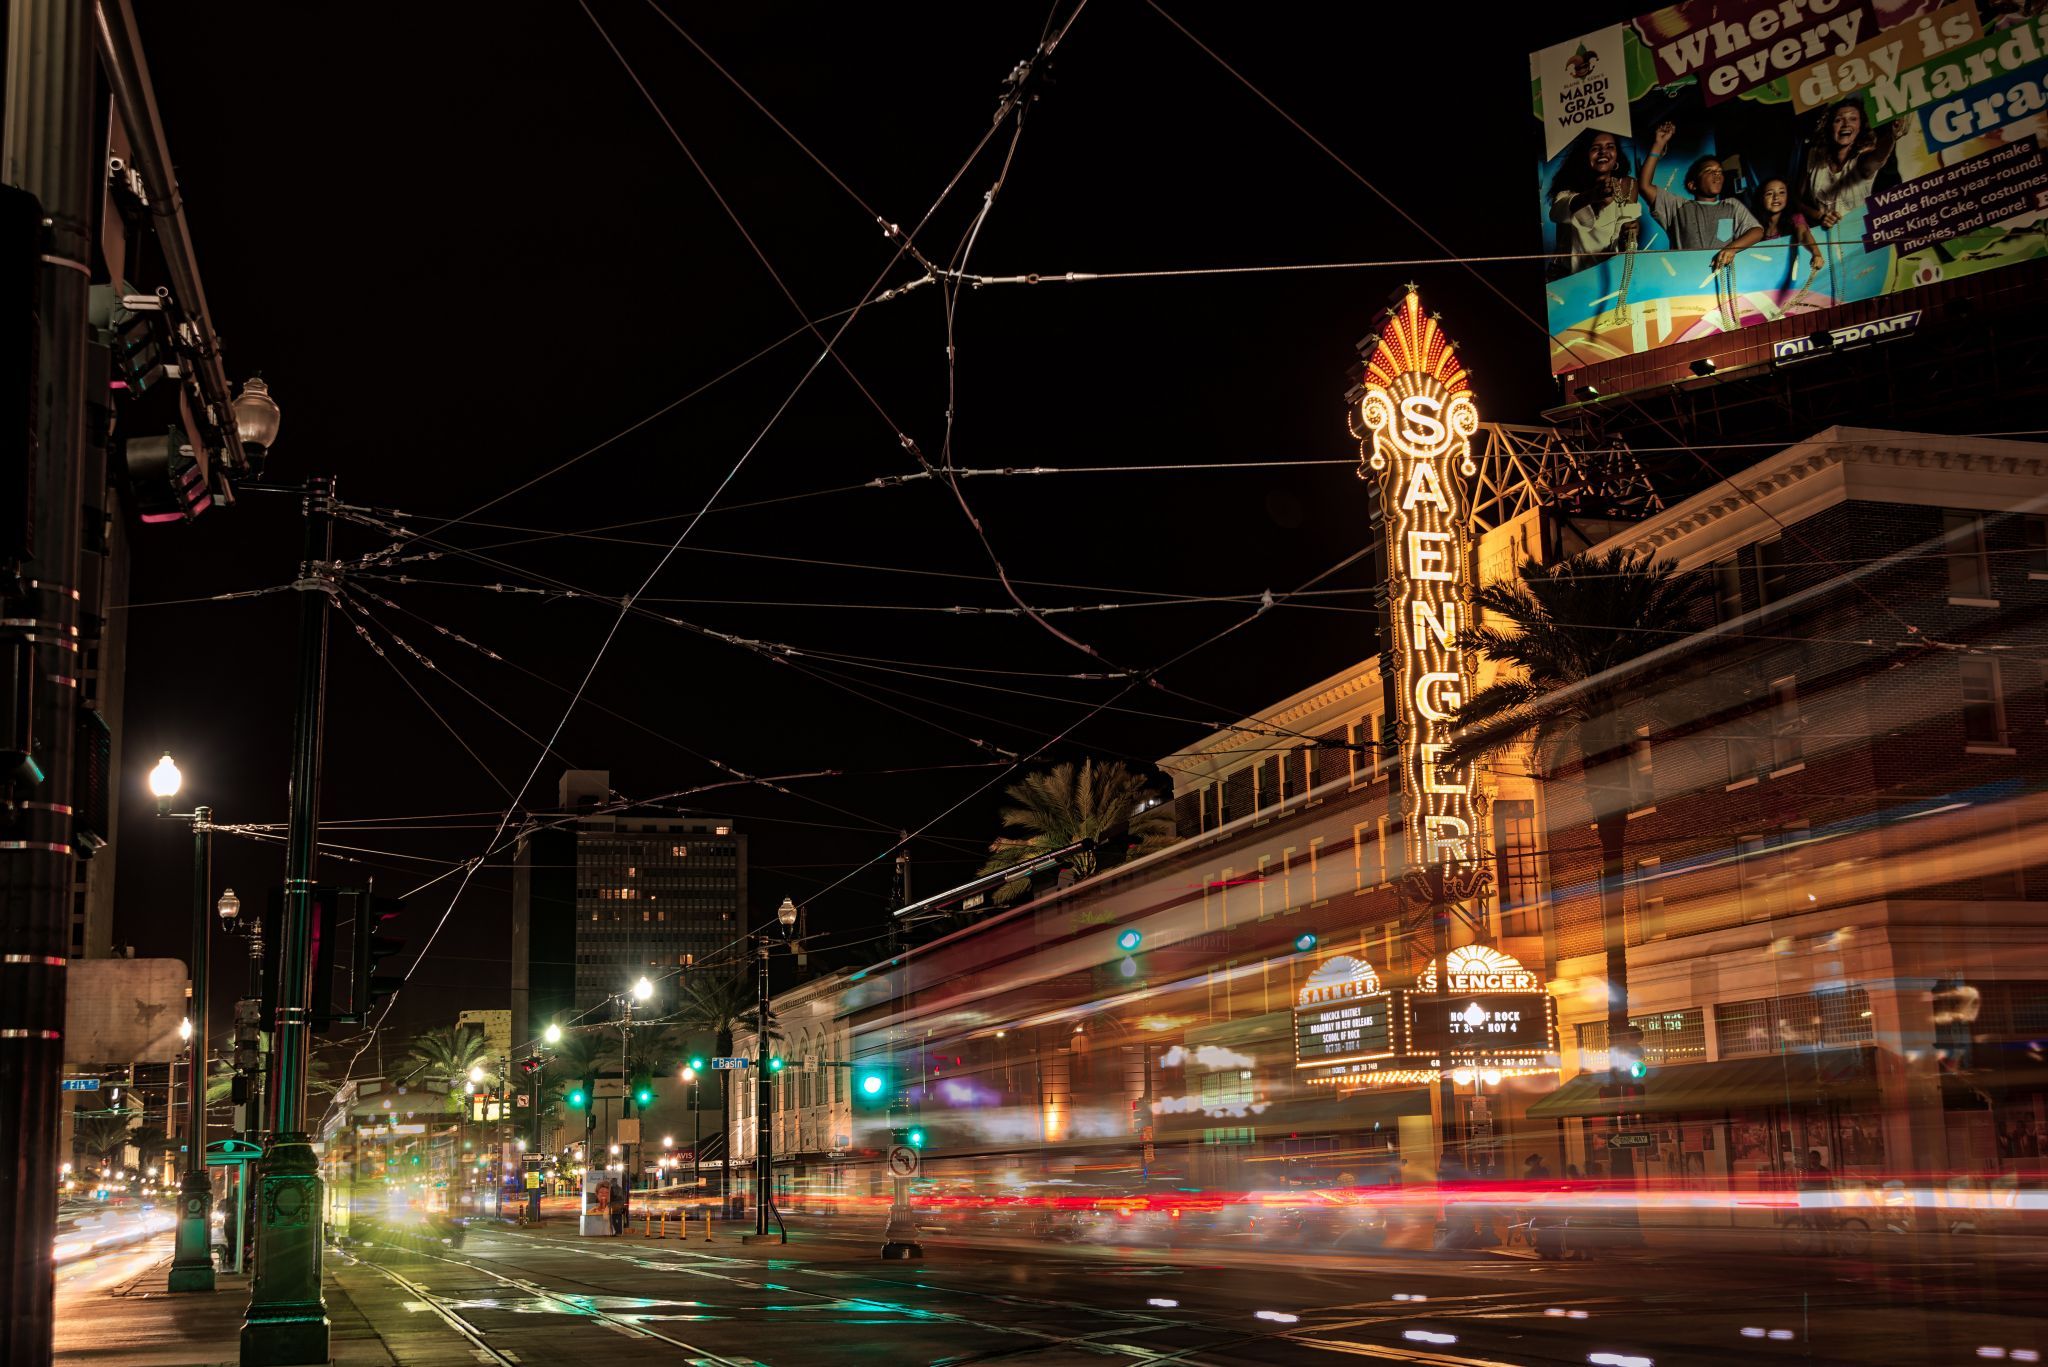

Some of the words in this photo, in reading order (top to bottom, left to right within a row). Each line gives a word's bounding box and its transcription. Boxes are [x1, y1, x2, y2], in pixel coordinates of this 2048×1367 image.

[1708, 8, 1863, 96] every
[1800, 40, 1904, 106] day
[1918, 11, 1975, 58] is
[1559, 77, 1609, 104] MARDI
[1564, 92, 1606, 114] GRAS
[1558, 102, 1615, 128] WORLD
[1929, 71, 2048, 144] Gra
[1874, 181, 1919, 208] Watch
[1921, 174, 1944, 190] our
[1947, 156, 1990, 181] artists
[1992, 142, 2031, 164] make
[1872, 202, 1918, 230] parade
[1919, 185, 1959, 210] floats
[1960, 153, 2043, 197] year-round!
[1872, 227, 1905, 246] Plus:
[1906, 212, 1939, 233] King
[1939, 199, 1979, 220] Cake,
[1903, 226, 1956, 252] movies,
[1957, 212, 1984, 232] and
[1985, 197, 2028, 222] more!
[1779, 315, 1913, 357] OUFRONT
[1400, 395, 1472, 868] SAENGER
[1302, 979, 1375, 1004] SAENGER
[1310, 1022, 1334, 1034] BROADWAY
[1341, 1019, 1351, 1029] NEW
[1352, 1016, 1373, 1028] ORLEANS
[1488, 1023, 1507, 1033] NOV
[1510, 1022, 1518, 1033] 4
[1495, 1011, 1521, 1022] ROCK
[1322, 1032, 1339, 1043] SCHOOL
[1340, 1031, 1347, 1040] OF
[1347, 1029, 1361, 1039] ROCK
[1325, 1043, 1334, 1053] OCT
[719, 1057, 743, 1069] Basin
[1502, 1059, 1515, 1067] 287
[1518, 1058, 1537, 1067] 0372
